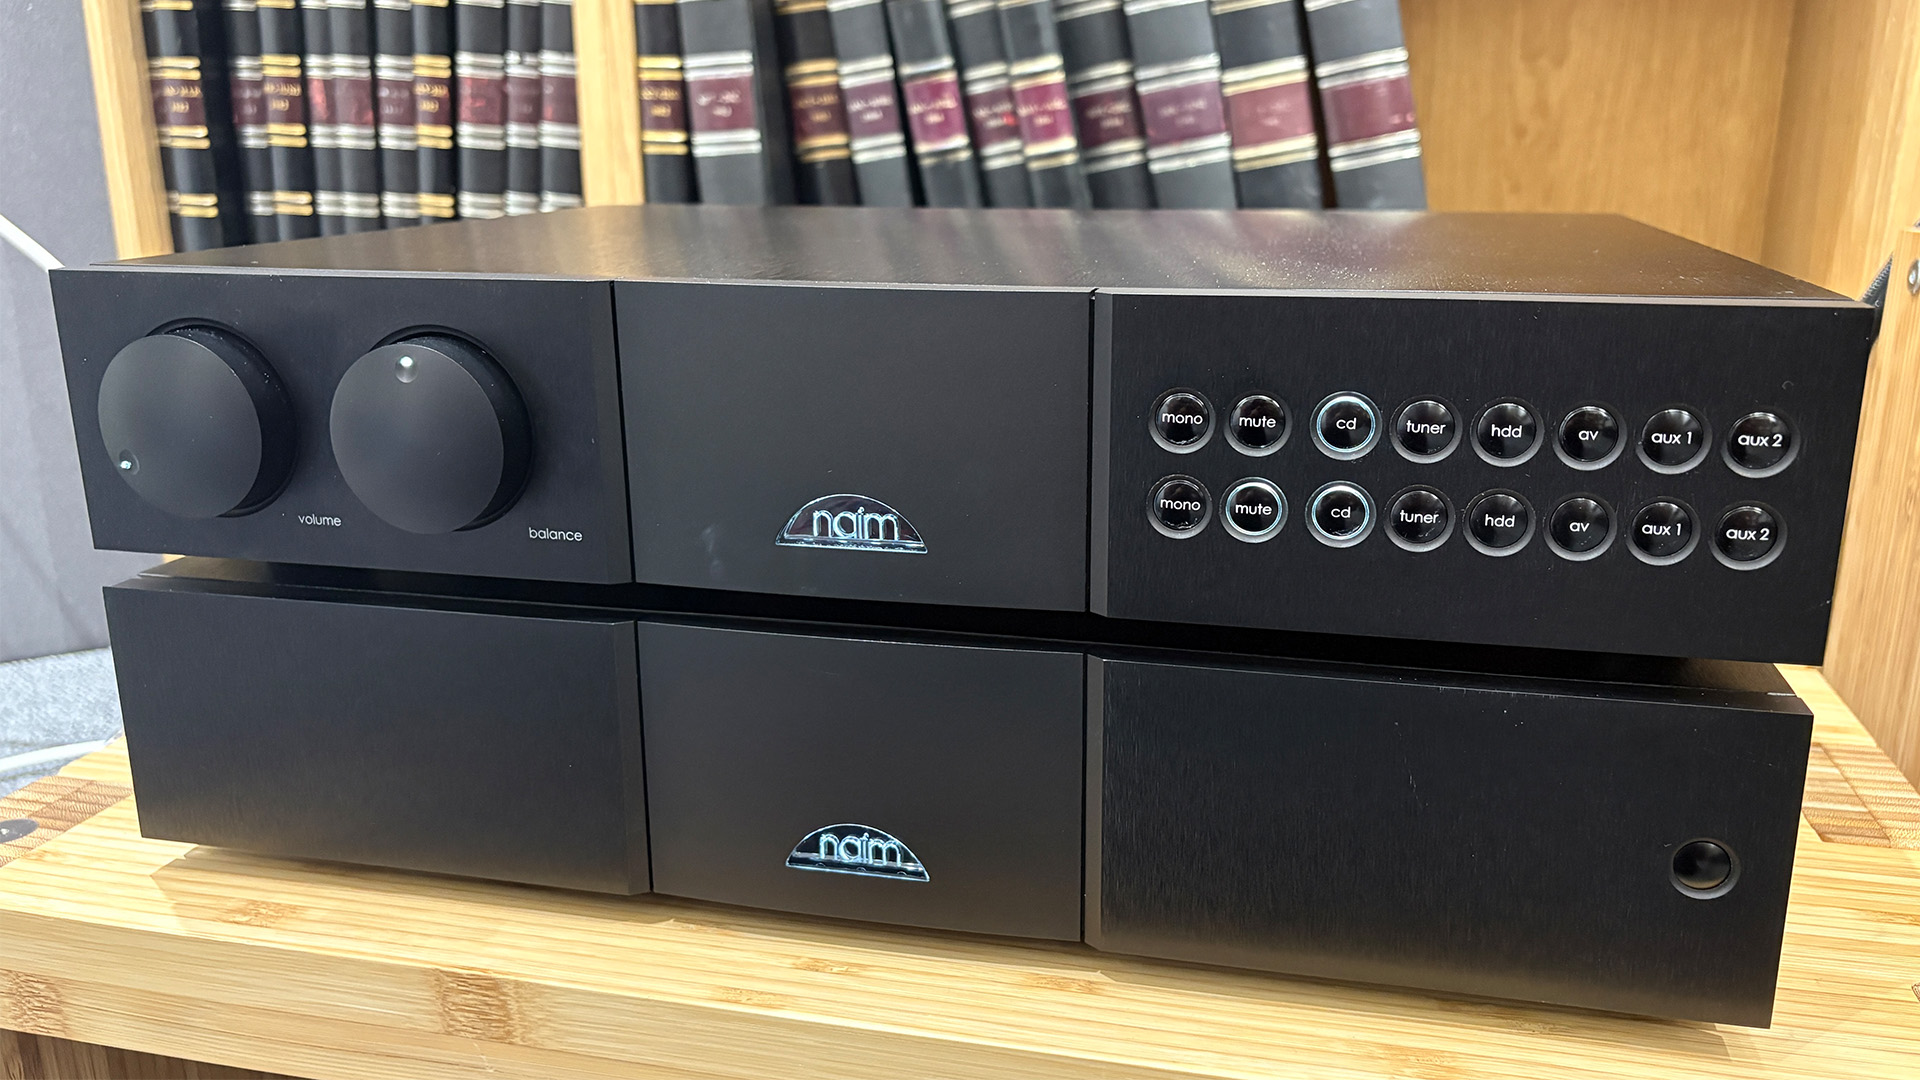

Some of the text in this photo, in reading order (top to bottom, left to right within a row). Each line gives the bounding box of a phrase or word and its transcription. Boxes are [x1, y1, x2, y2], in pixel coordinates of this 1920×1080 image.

[1161, 413, 1203, 425] mono
[1238, 415, 1277, 429] mute
[1335, 417, 1357, 430] cd
[1405, 419, 1447, 435] tuner
[1490, 423, 1523, 439] hdd
[1578, 429, 1599, 441] av
[1651, 431, 1693, 445] aux 1
[1737, 433, 1783, 448] aux 2
[1159, 499, 1201, 511] mono
[1234, 502, 1273, 516] mute
[1330, 506, 1351, 519] cd
[1399, 509, 1440, 524] tuner
[297, 513, 342, 527] volume
[812, 506, 899, 541] naim
[1484, 514, 1516, 528] hdd
[1569, 521, 1590, 533] av
[528, 527, 583, 542] balance
[1641, 523, 1682, 536] aux 1
[1725, 527, 1770, 541] aux 2
[819, 832, 903, 867] naim
